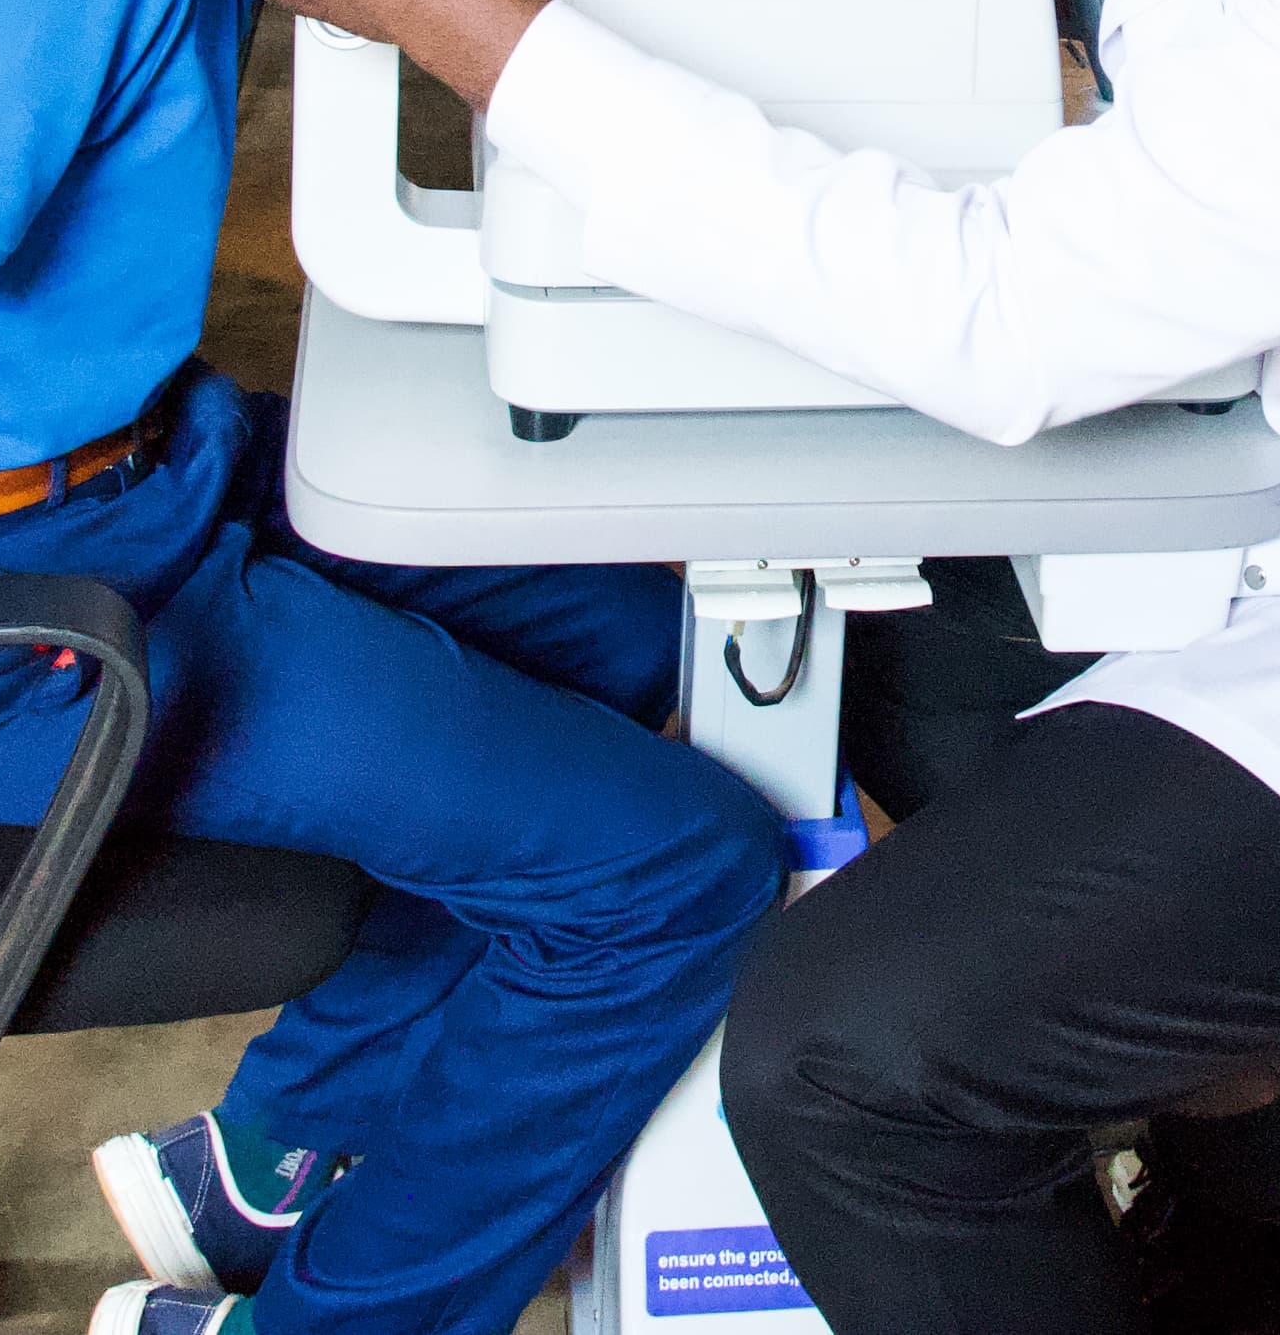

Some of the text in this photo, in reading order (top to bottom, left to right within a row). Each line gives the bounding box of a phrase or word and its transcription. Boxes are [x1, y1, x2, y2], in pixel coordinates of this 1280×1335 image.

[658, 1252, 716, 1268] ensure
[719, 1249, 745, 1266] the
[658, 1274, 699, 1291] been
